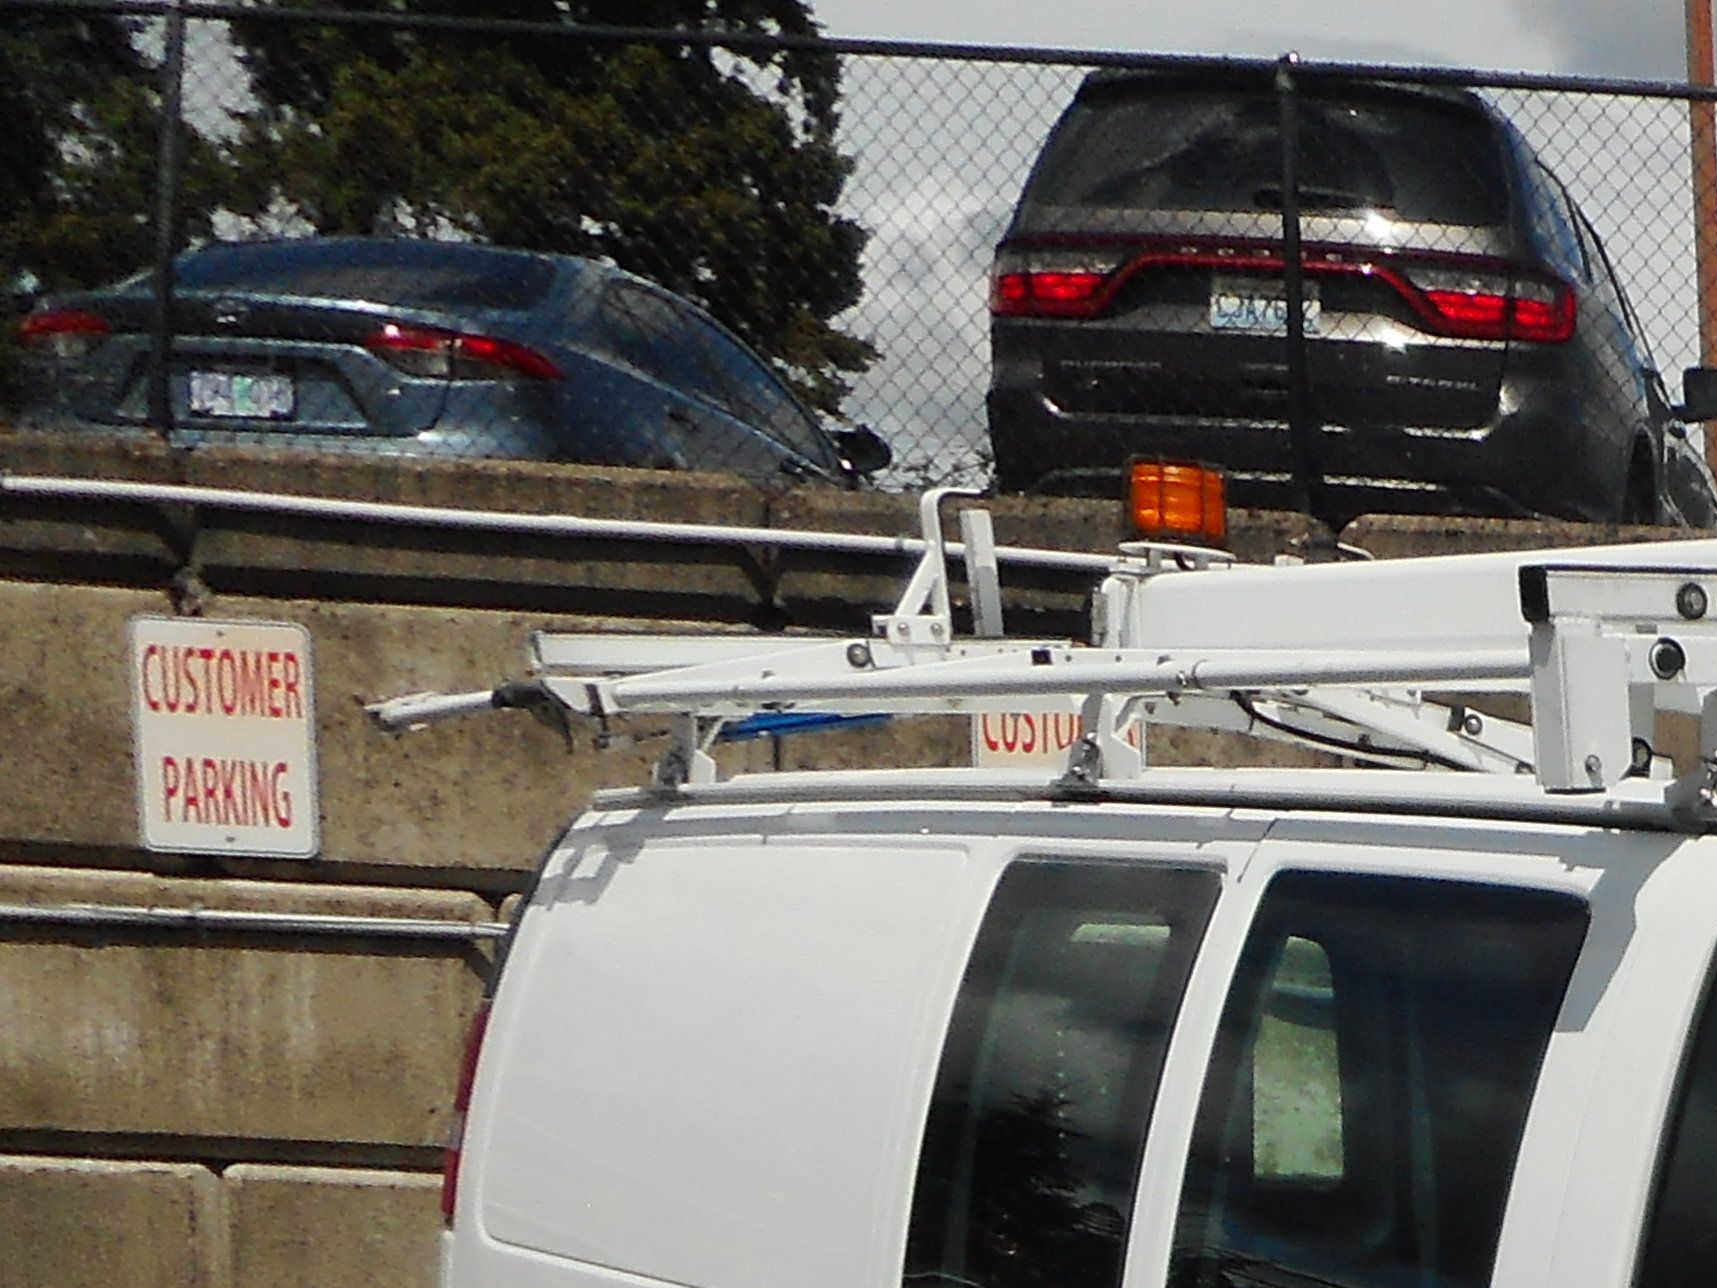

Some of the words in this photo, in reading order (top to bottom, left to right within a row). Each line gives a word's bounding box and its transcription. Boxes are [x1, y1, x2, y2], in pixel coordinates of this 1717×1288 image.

[142, 644, 303, 719] CUSTOMER
[982, 712, 1136, 754] CUSTO
[161, 756, 291, 828] PARKING
